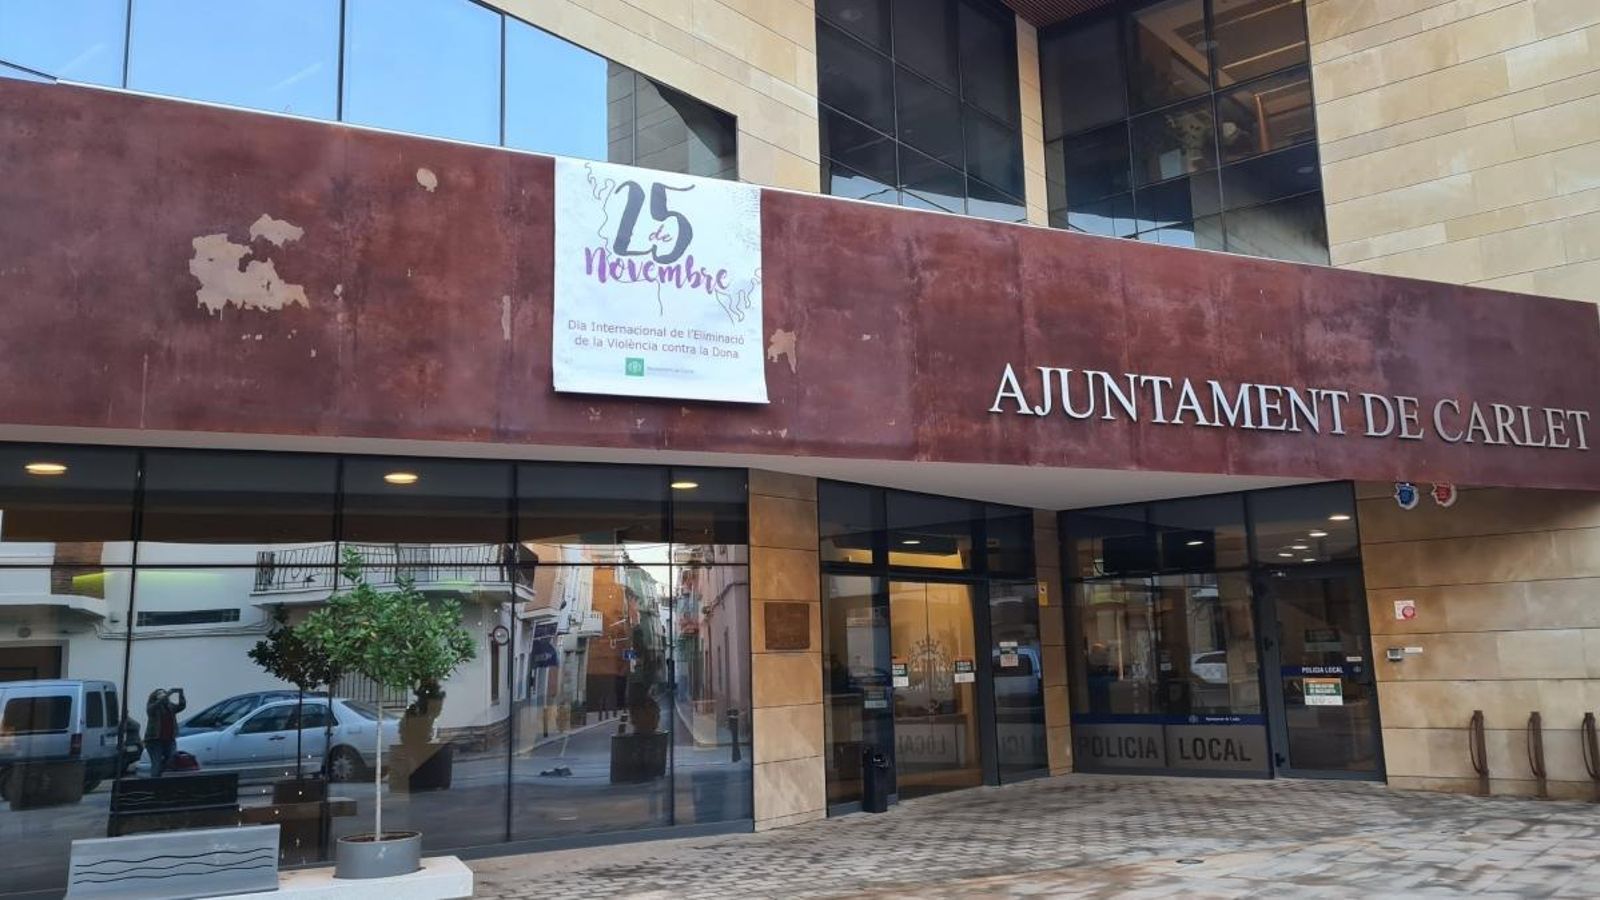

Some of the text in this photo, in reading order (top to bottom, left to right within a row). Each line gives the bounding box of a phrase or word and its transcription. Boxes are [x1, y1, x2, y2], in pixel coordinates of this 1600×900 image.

[613, 180, 695, 264] 25
[648, 224, 672, 242] de
[584, 246, 730, 294] Novembre
[568, 319, 745, 345] Dia Internacional de l'Eliminació
[575, 335, 739, 359] de la Violència contra la Dona
[988, 362, 1591, 450] AJUNTAMENT DE CARLET
[1078, 735, 1252, 762] POLICIA LOCAL
